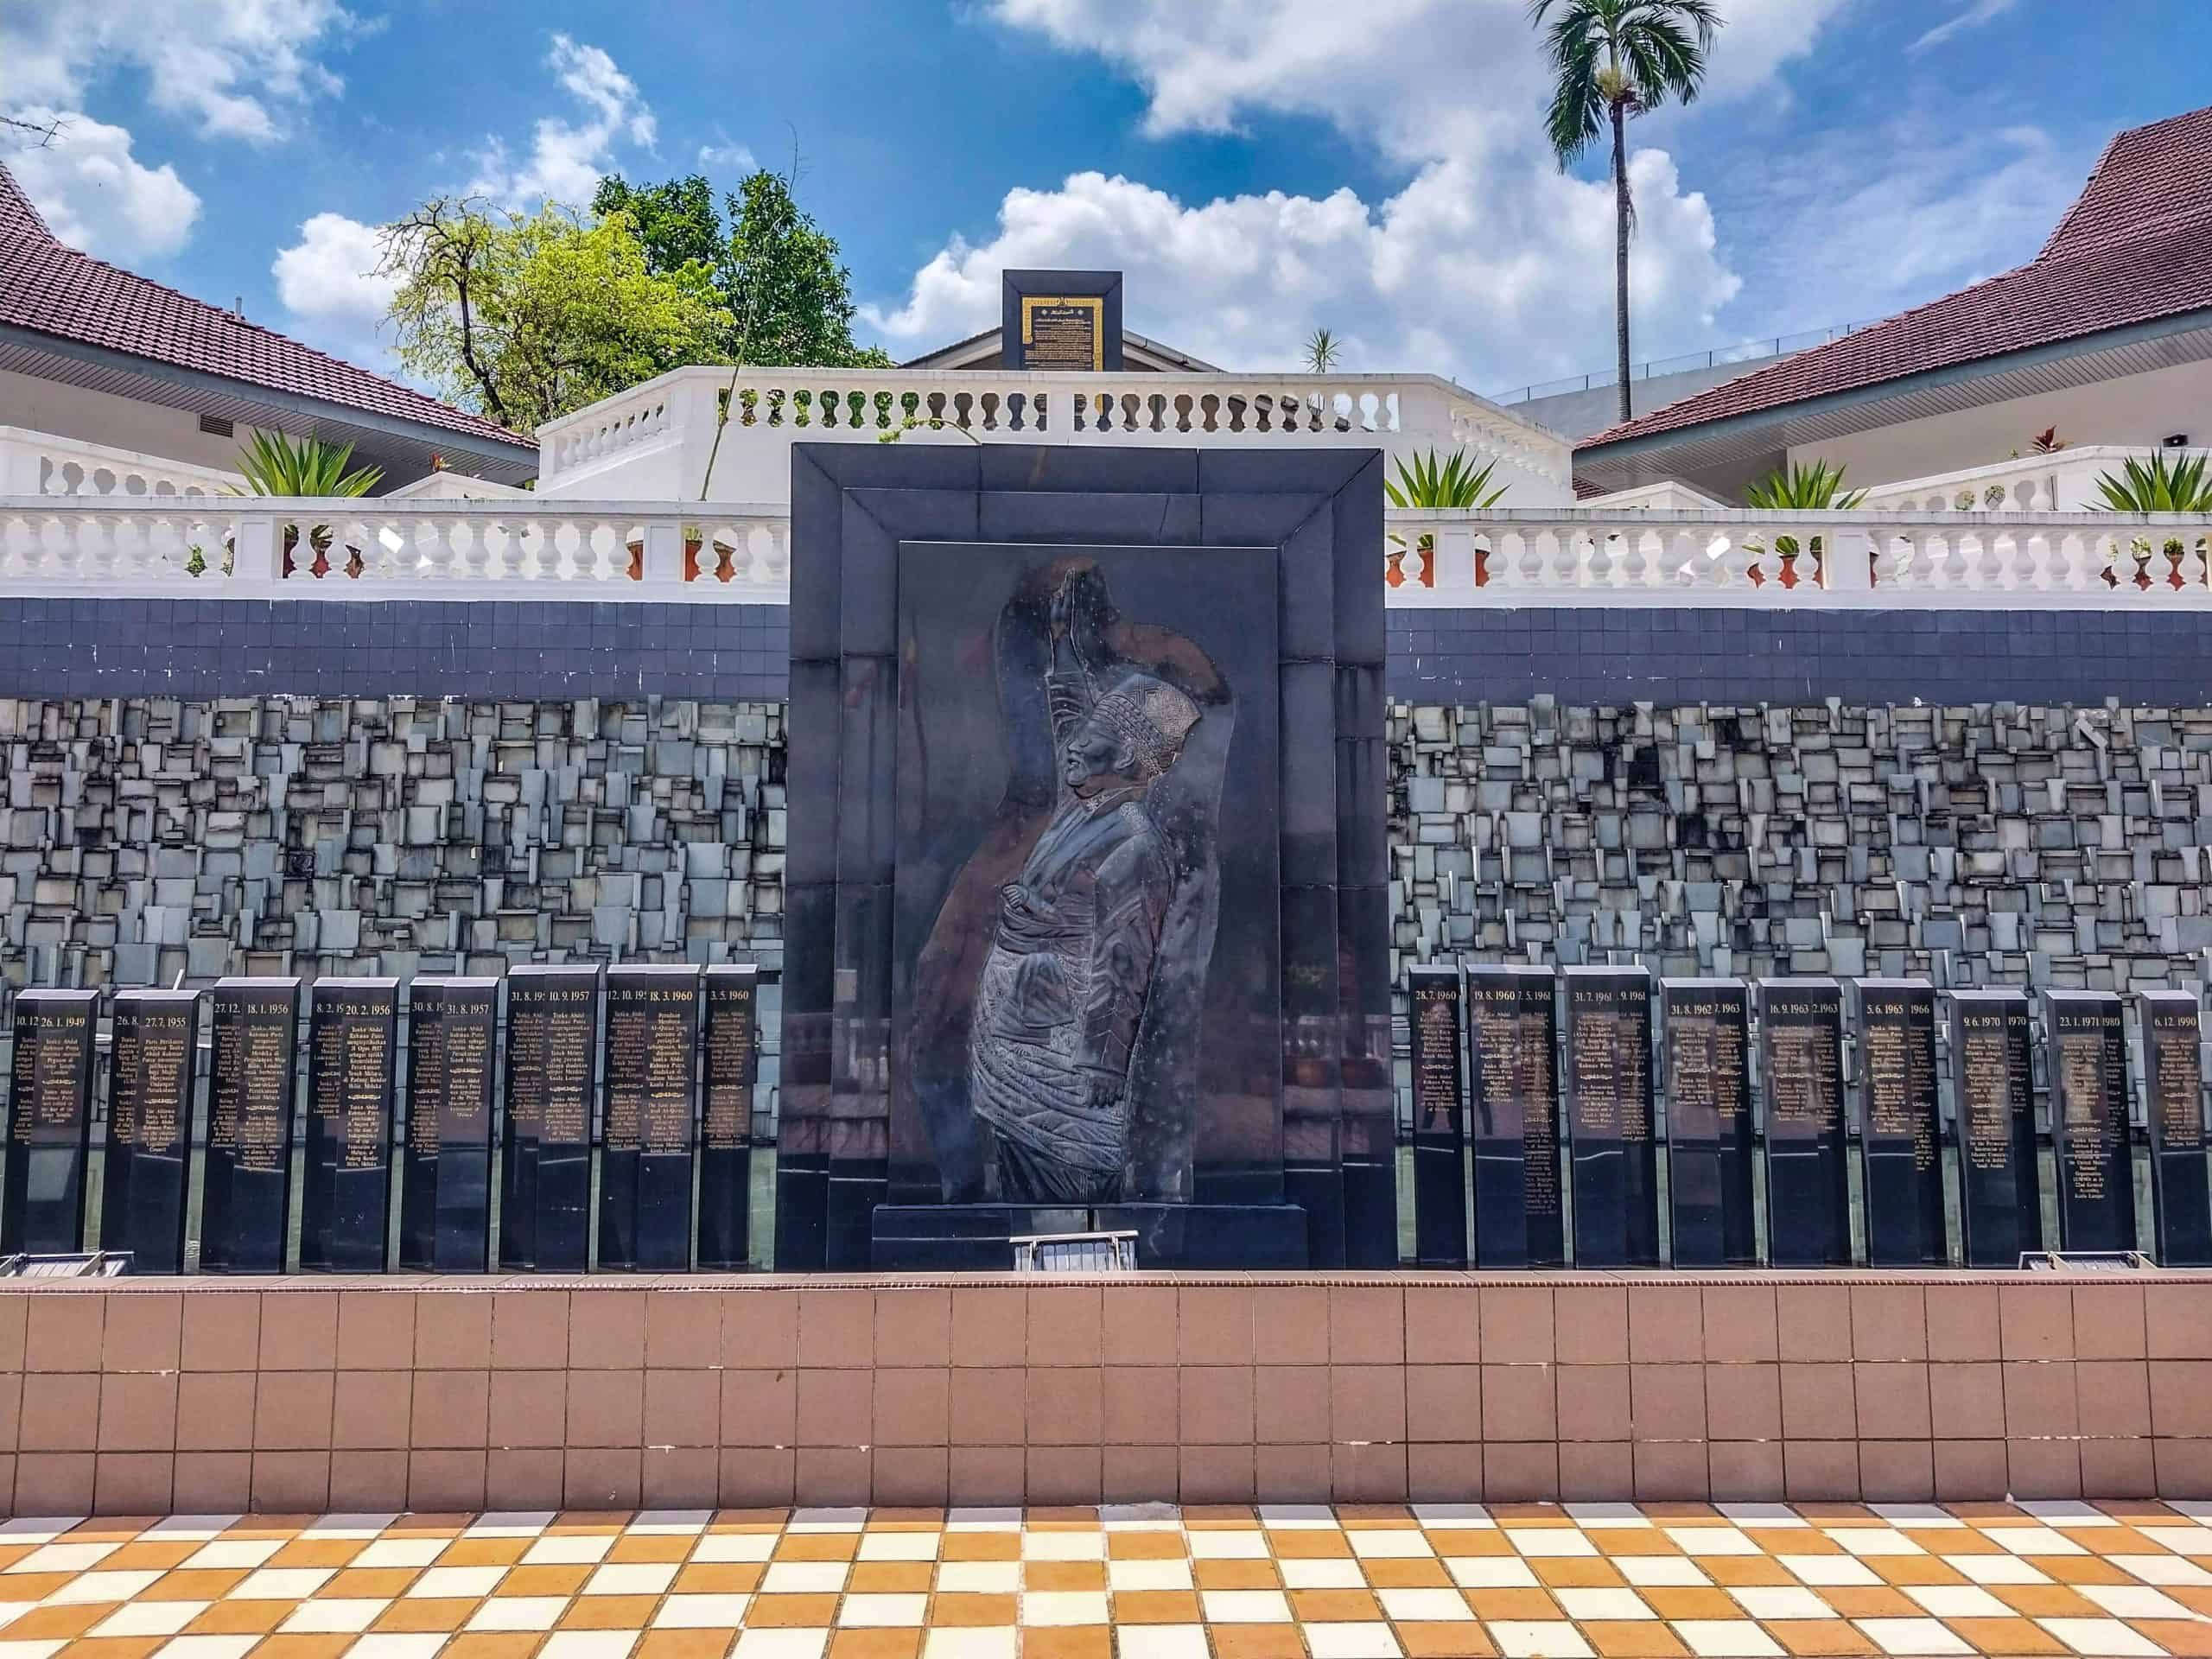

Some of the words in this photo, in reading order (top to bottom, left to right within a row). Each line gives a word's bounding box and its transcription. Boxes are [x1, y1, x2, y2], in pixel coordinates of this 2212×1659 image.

[534, 991, 545, 1001] 19
[571, 991, 589, 1001] 1957
[672, 991, 693, 1001] 1960
[729, 990, 748, 1001] 1960
[1437, 990, 1456, 1001] 1960
[1495, 990, 1515, 1001] 1960
[1630, 991, 1645, 1001] 1961
[270, 1004, 289, 1014] 1956
[372, 1004, 391, 1014] 1956
[470, 1004, 489, 1014] 1957
[1693, 1004, 1713, 1014] 1962
[1722, 1004, 1740, 1014] 1963
[1790, 1004, 1809, 1014] 1963
[1885, 1004, 1904, 1014] 1965
[1910, 1005, 1929, 1014] 1966
[66, 1017, 85, 1027] 1949
[168, 1017, 187, 1027] 1955
[1981, 1016, 2000, 1027] 1970
[2008, 1016, 2026, 1026] 1970
[2082, 1016, 2100, 1027] 1971
[2177, 1016, 2196, 1027] 1990
